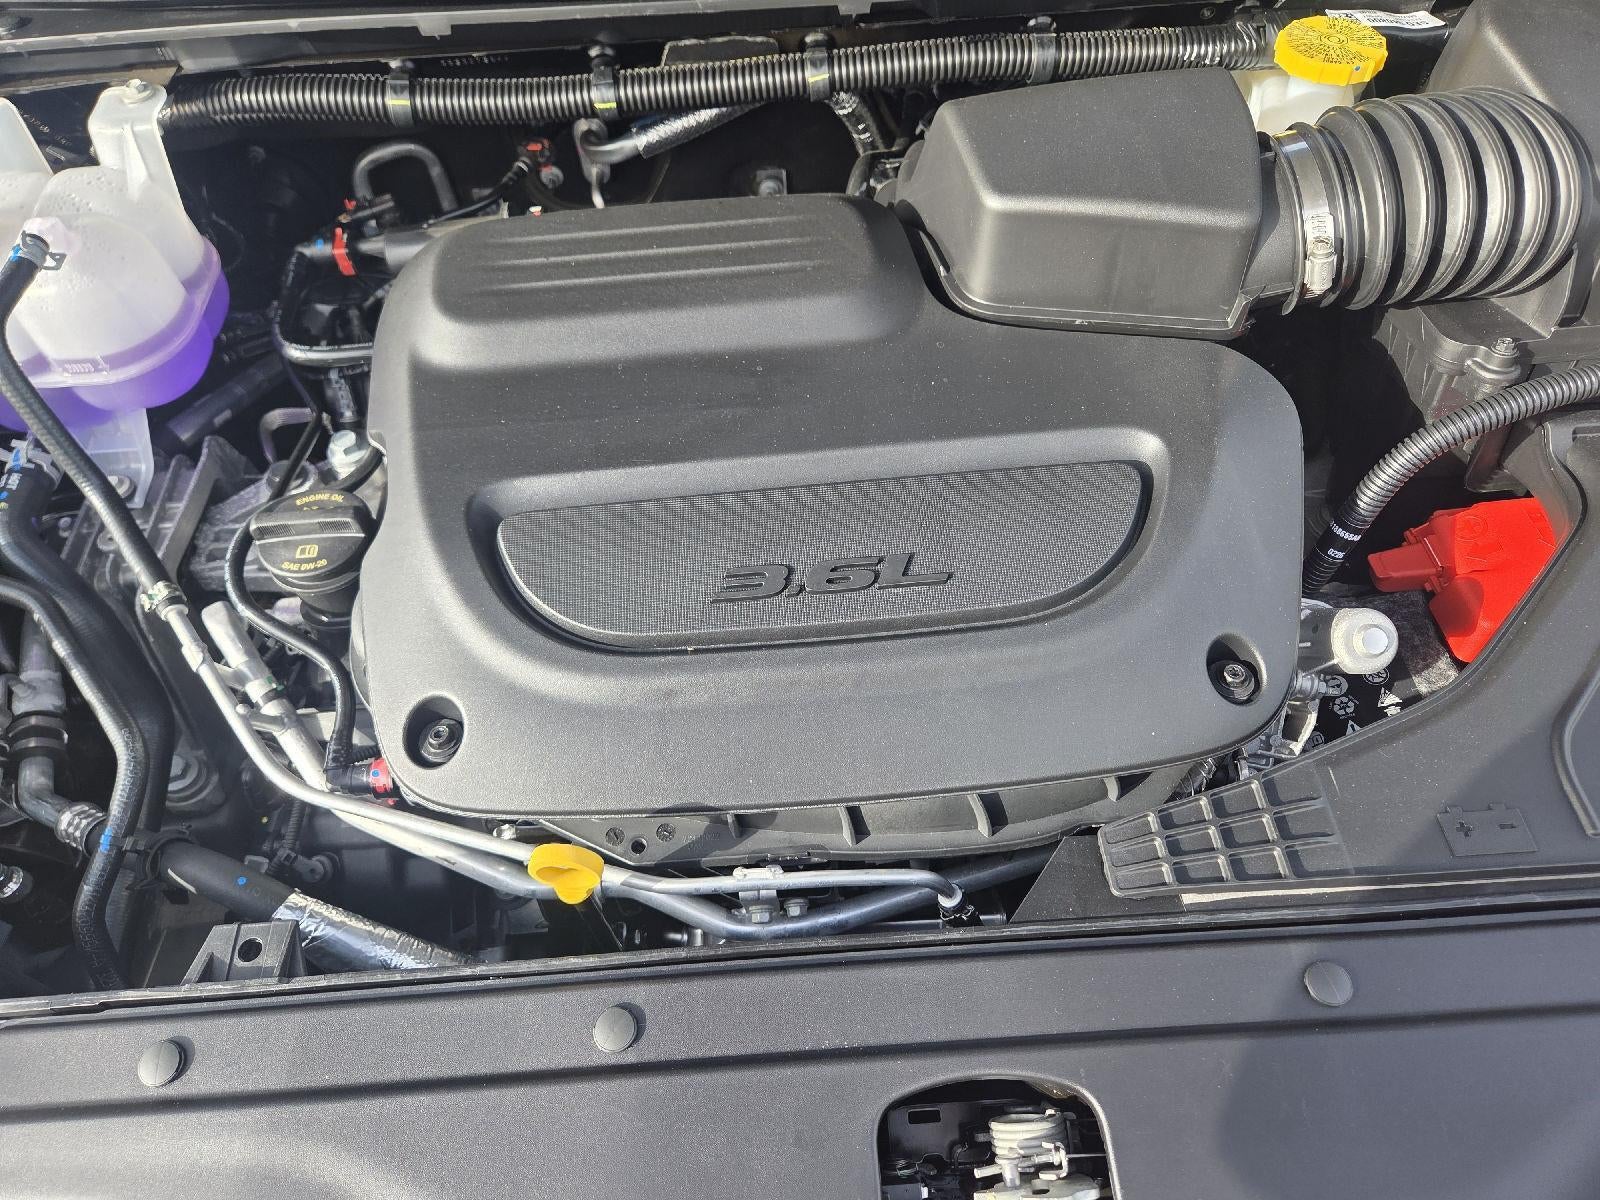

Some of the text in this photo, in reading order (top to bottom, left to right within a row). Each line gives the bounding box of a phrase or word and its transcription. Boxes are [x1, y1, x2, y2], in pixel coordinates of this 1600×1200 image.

[295, 493, 345, 506] ENGINE OIL
[281, 559, 328, 571] SAE 0W-20
[711, 552, 952, 604] 3.6L
